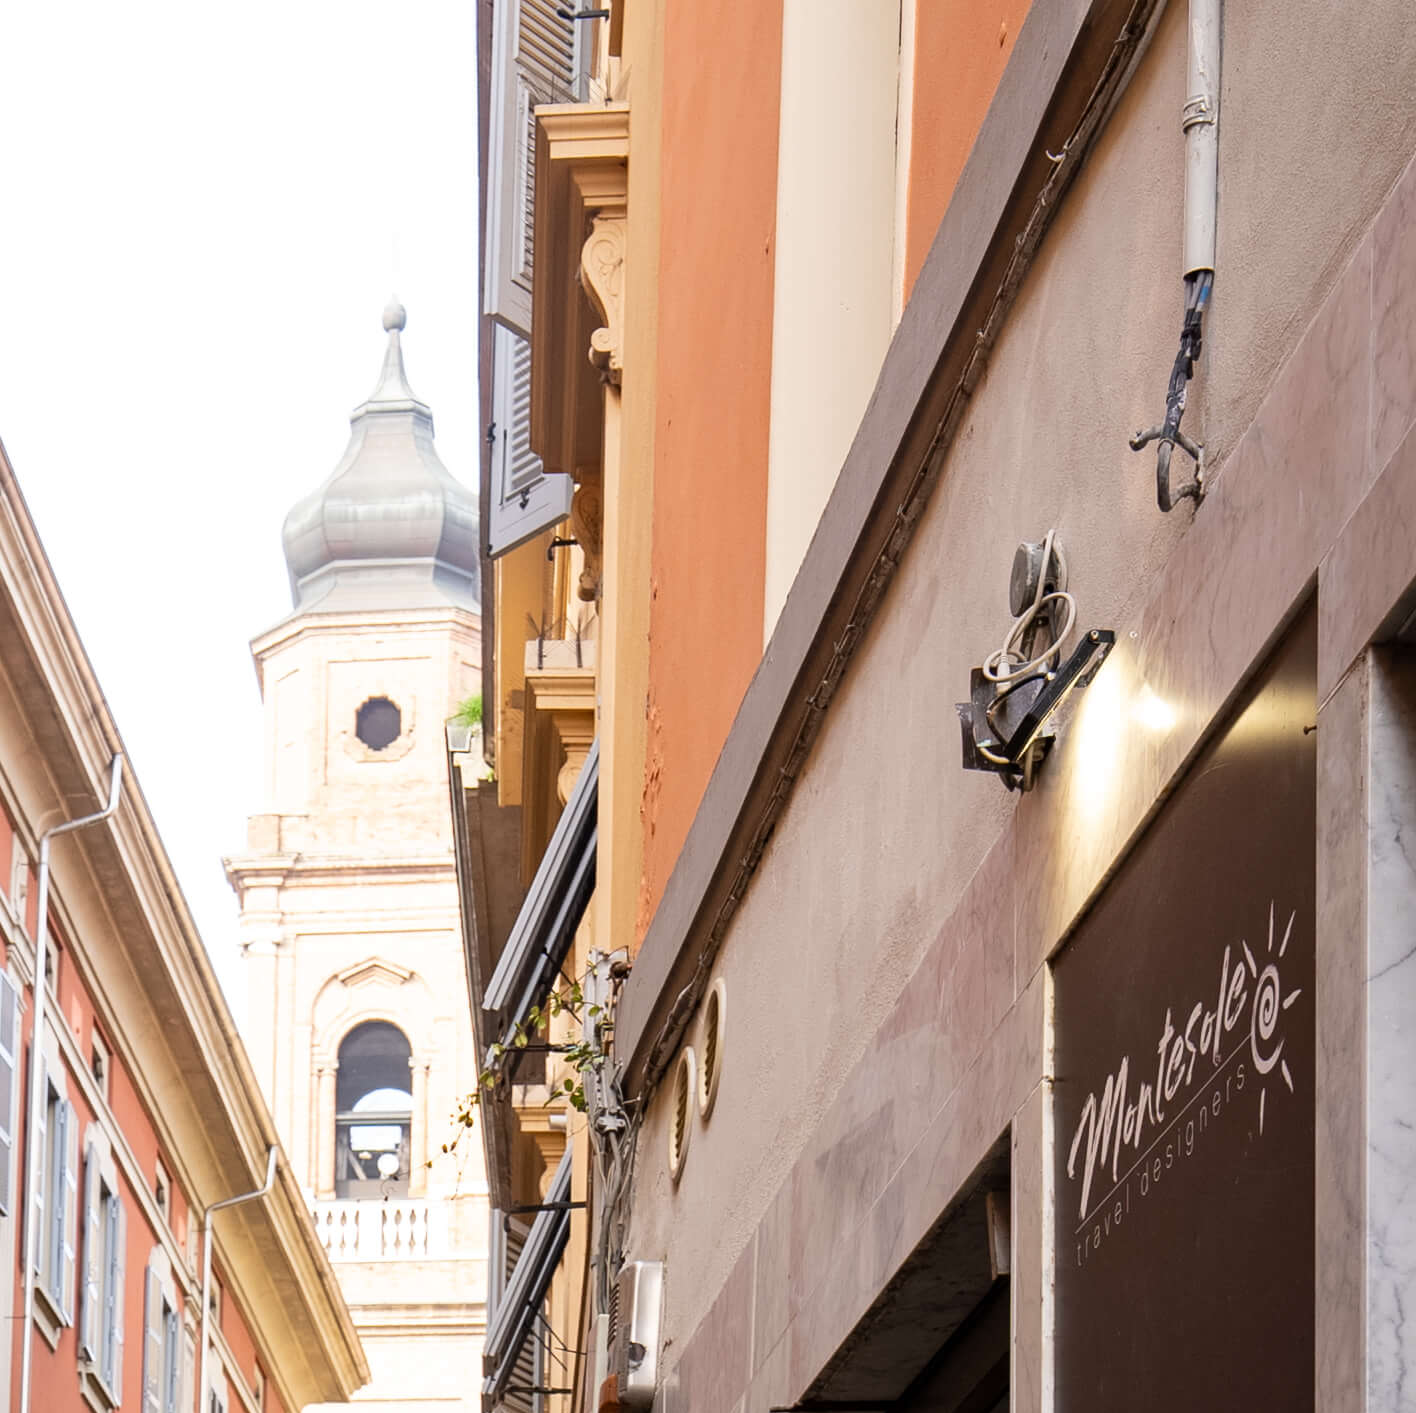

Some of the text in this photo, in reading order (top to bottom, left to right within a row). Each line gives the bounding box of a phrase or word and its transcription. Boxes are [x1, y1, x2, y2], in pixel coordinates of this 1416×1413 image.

[1067, 945, 1247, 1219] Montesole
[1077, 1063, 1245, 1266] travel designers
